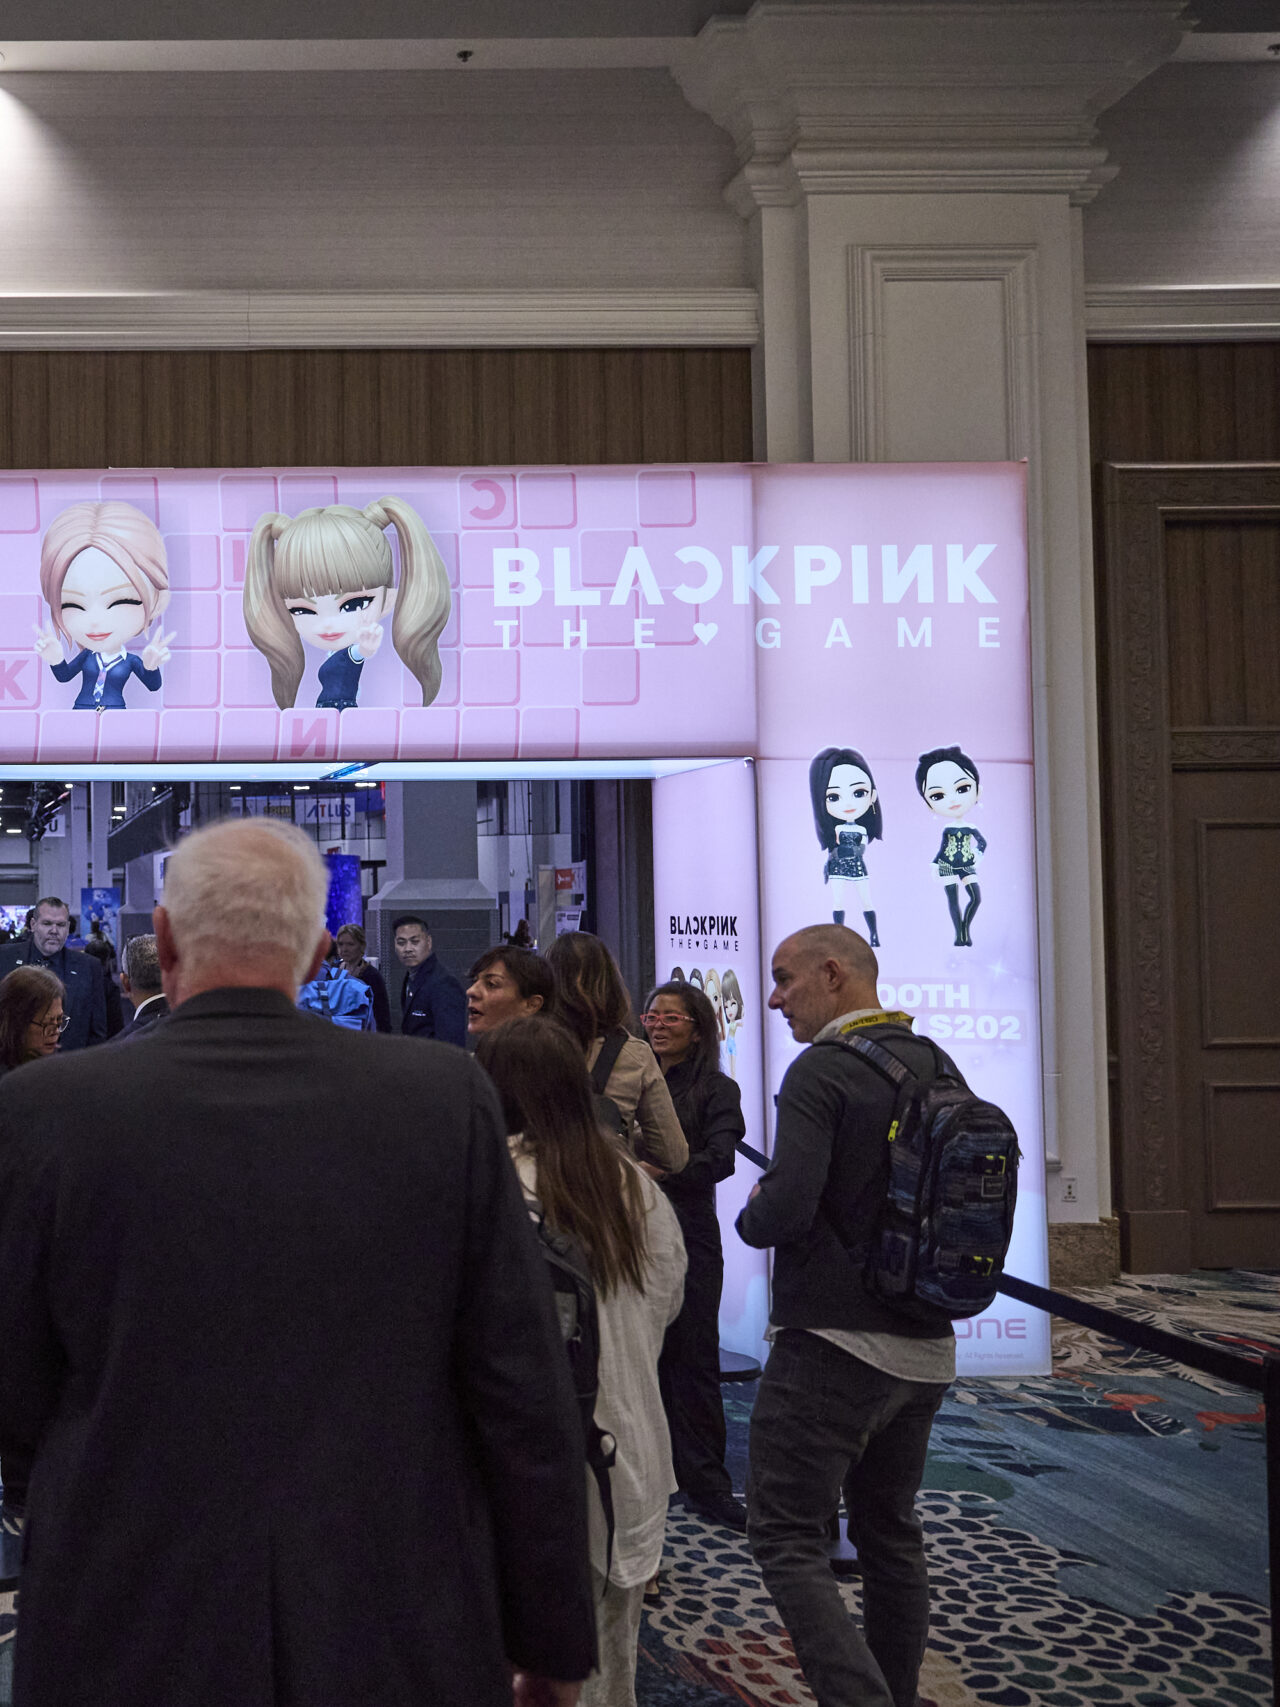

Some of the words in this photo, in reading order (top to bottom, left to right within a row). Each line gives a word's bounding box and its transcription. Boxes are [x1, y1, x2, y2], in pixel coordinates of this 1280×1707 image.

[494, 618, 656, 650] THE
[755, 616, 1000, 649] GAME
[307, 803, 351, 818] ATLUS
[670, 937, 692, 950] THE
[703, 938, 739, 952] GAME
[877, 983, 970, 1009] OOTH
[928, 1014, 1022, 1040] S202
